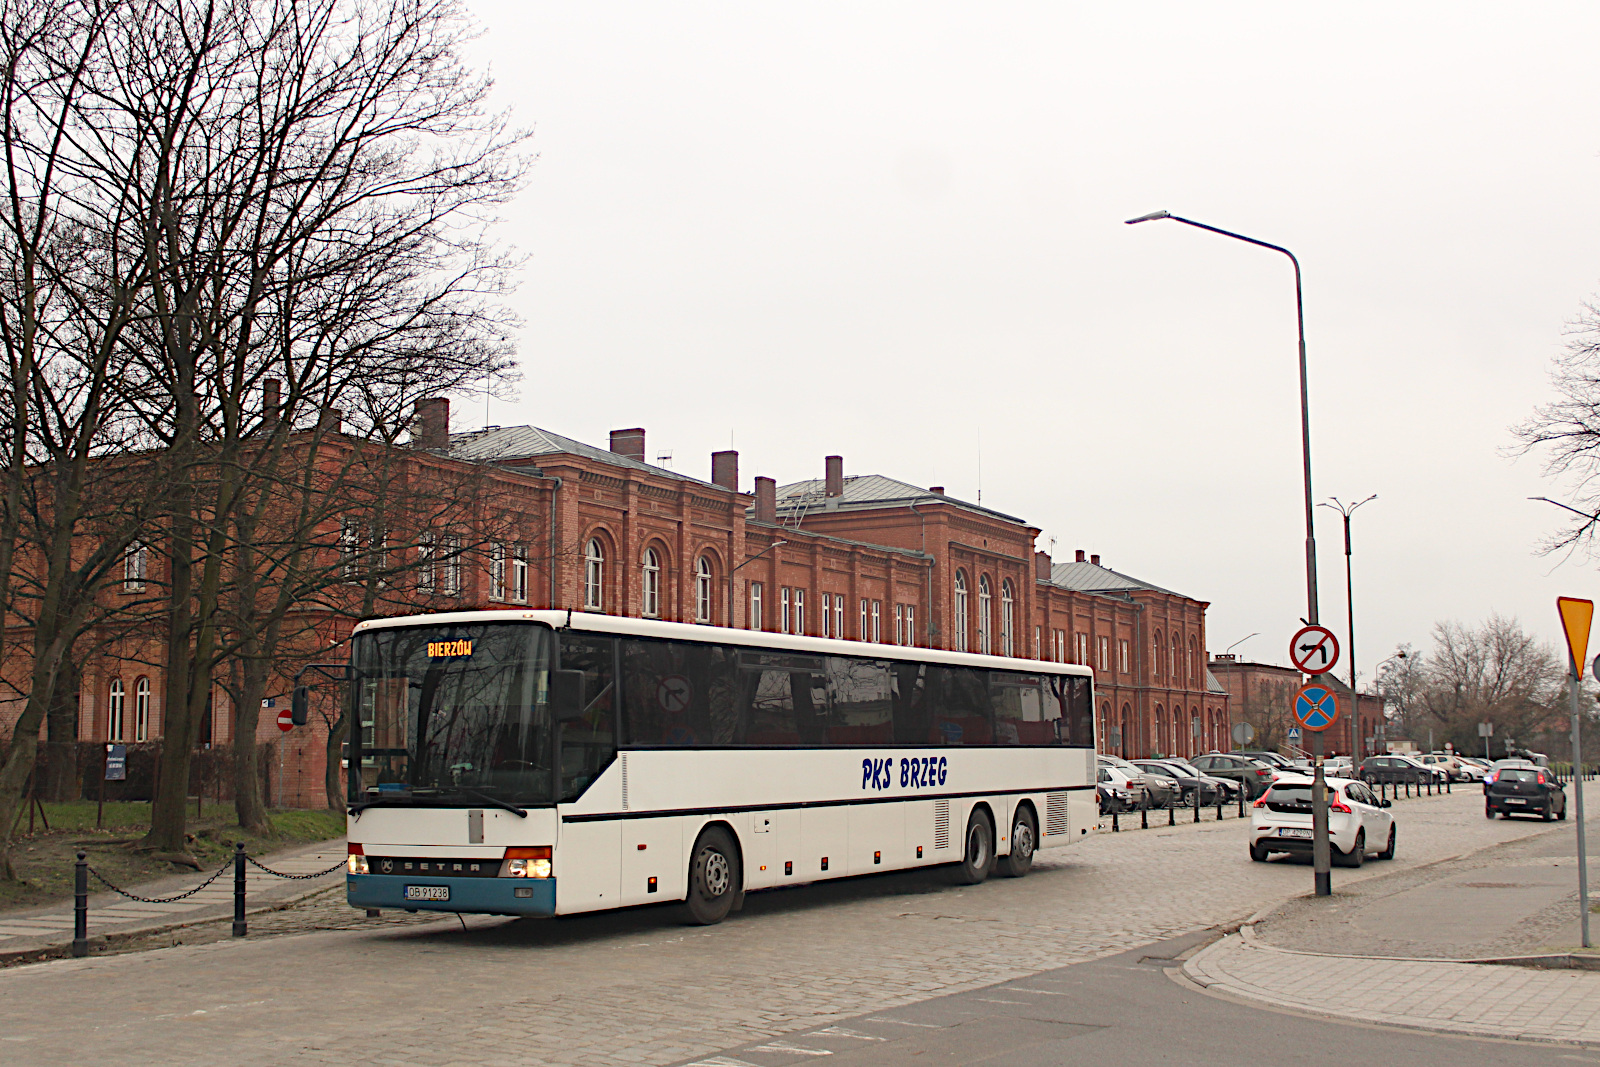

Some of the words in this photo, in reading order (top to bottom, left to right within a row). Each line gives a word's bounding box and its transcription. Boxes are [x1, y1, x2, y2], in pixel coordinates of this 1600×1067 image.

[427, 639, 472, 657] BIERZÓW
[862, 757, 893, 791] PKS
[900, 756, 948, 790] BRZEG
[404, 862, 480, 872] SETRA
[409, 887, 421, 897] OB
[422, 887, 448, 898] 91238
